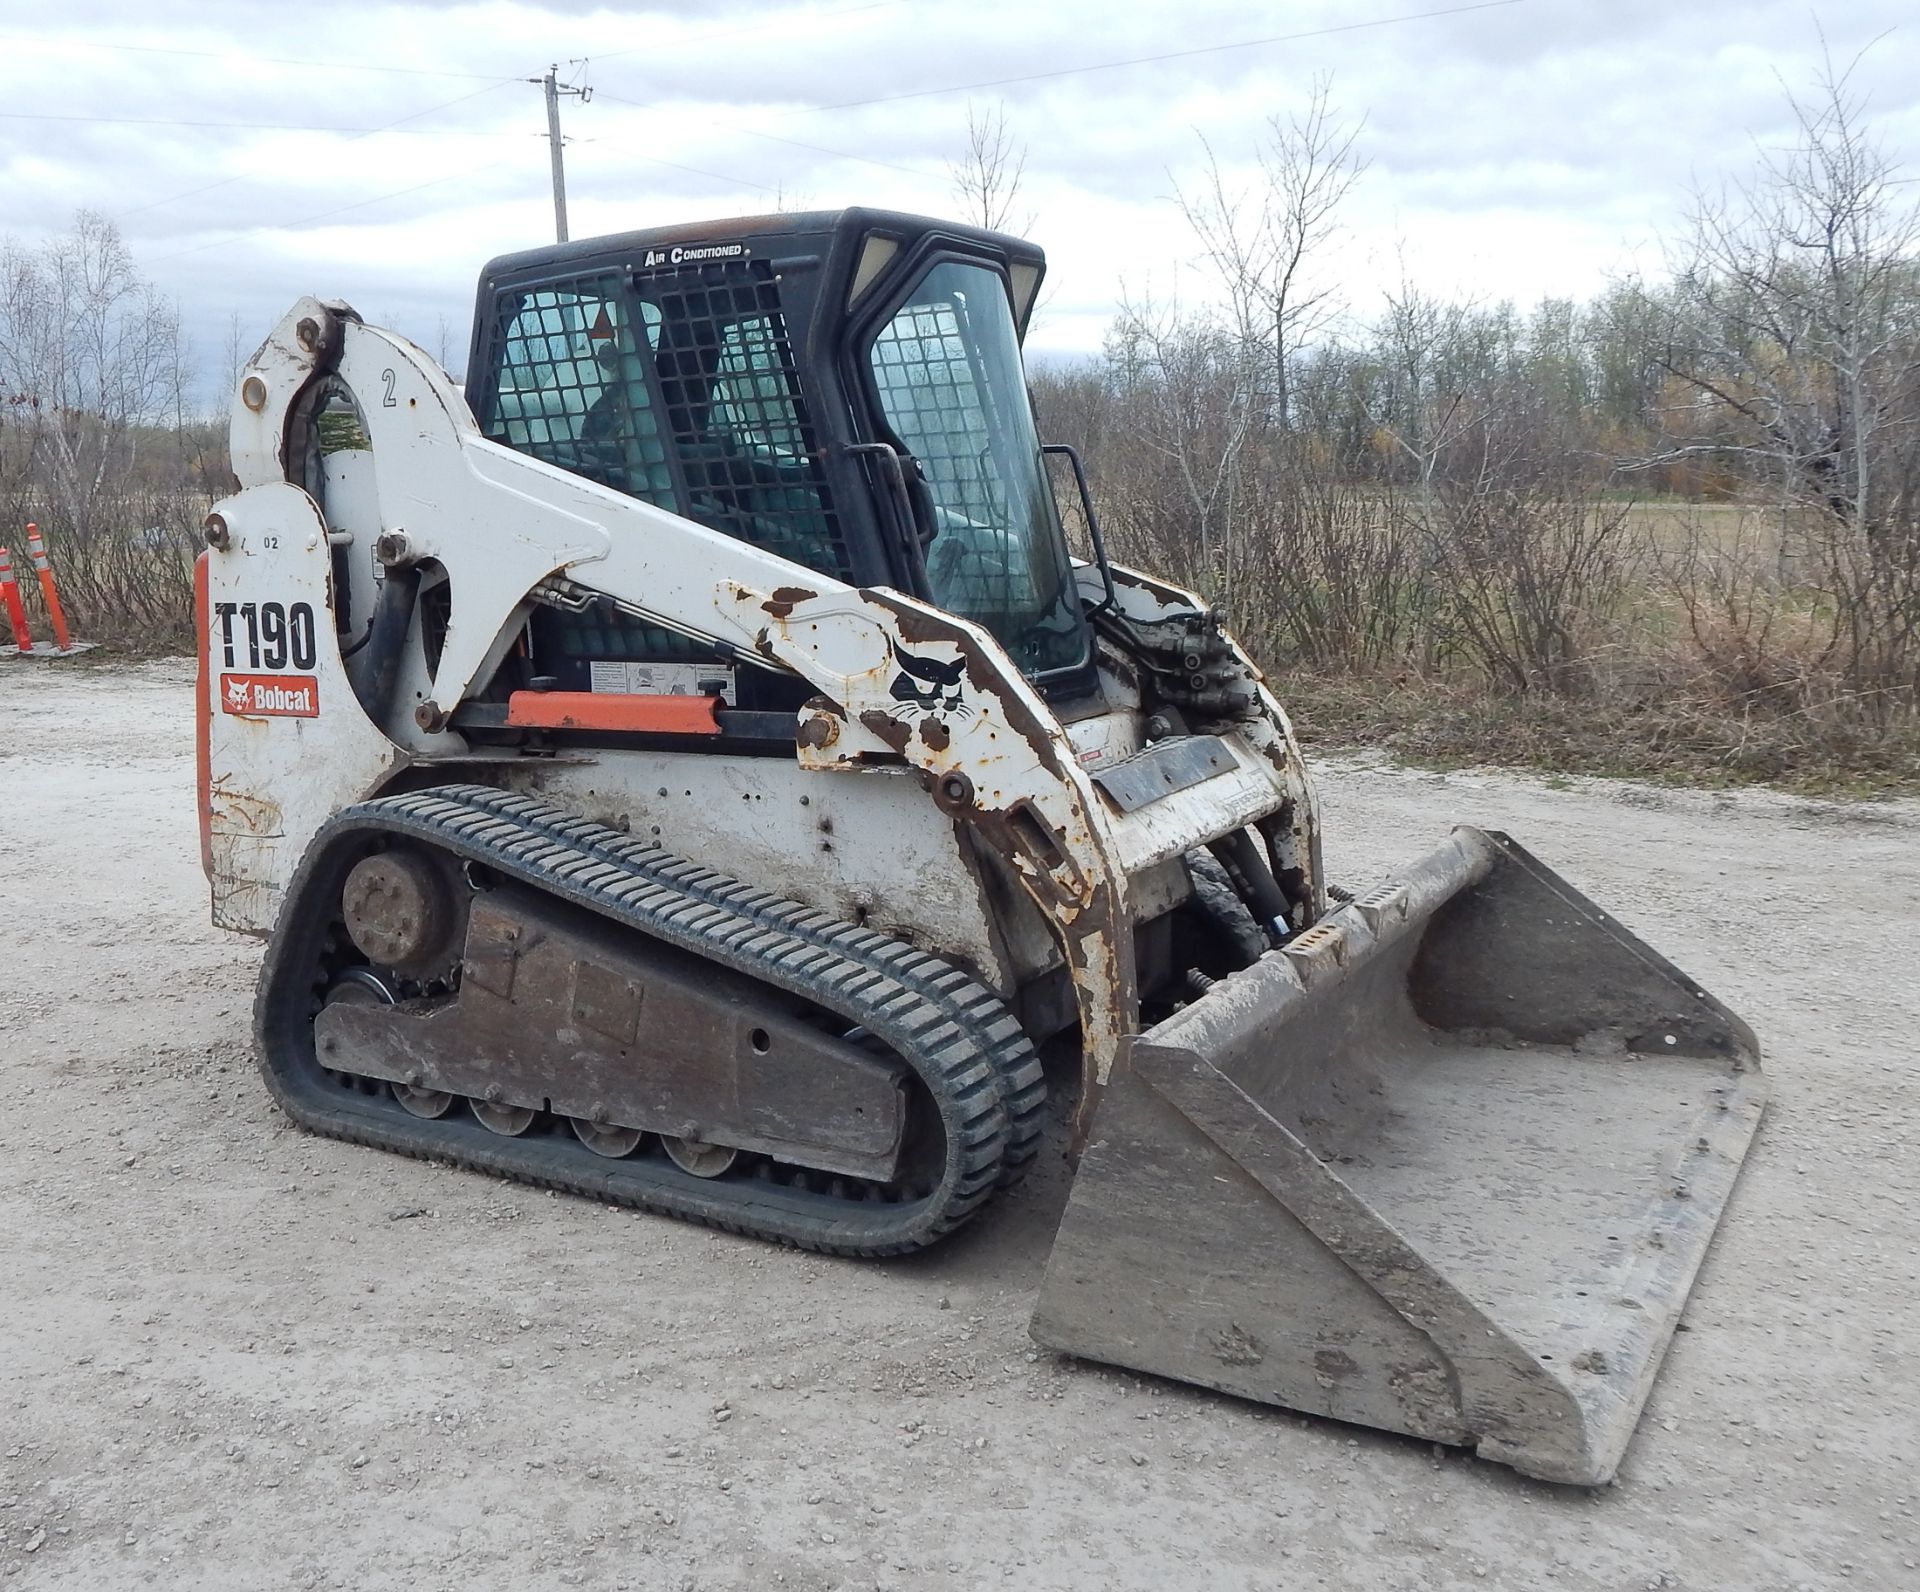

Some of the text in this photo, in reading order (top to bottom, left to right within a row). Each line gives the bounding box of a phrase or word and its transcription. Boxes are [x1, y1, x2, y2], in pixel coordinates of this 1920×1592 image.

[381, 368, 397, 408] 2
[263, 537, 278, 549] 02
[215, 602, 316, 670] T190
[254, 685, 311, 711] Bobcat
